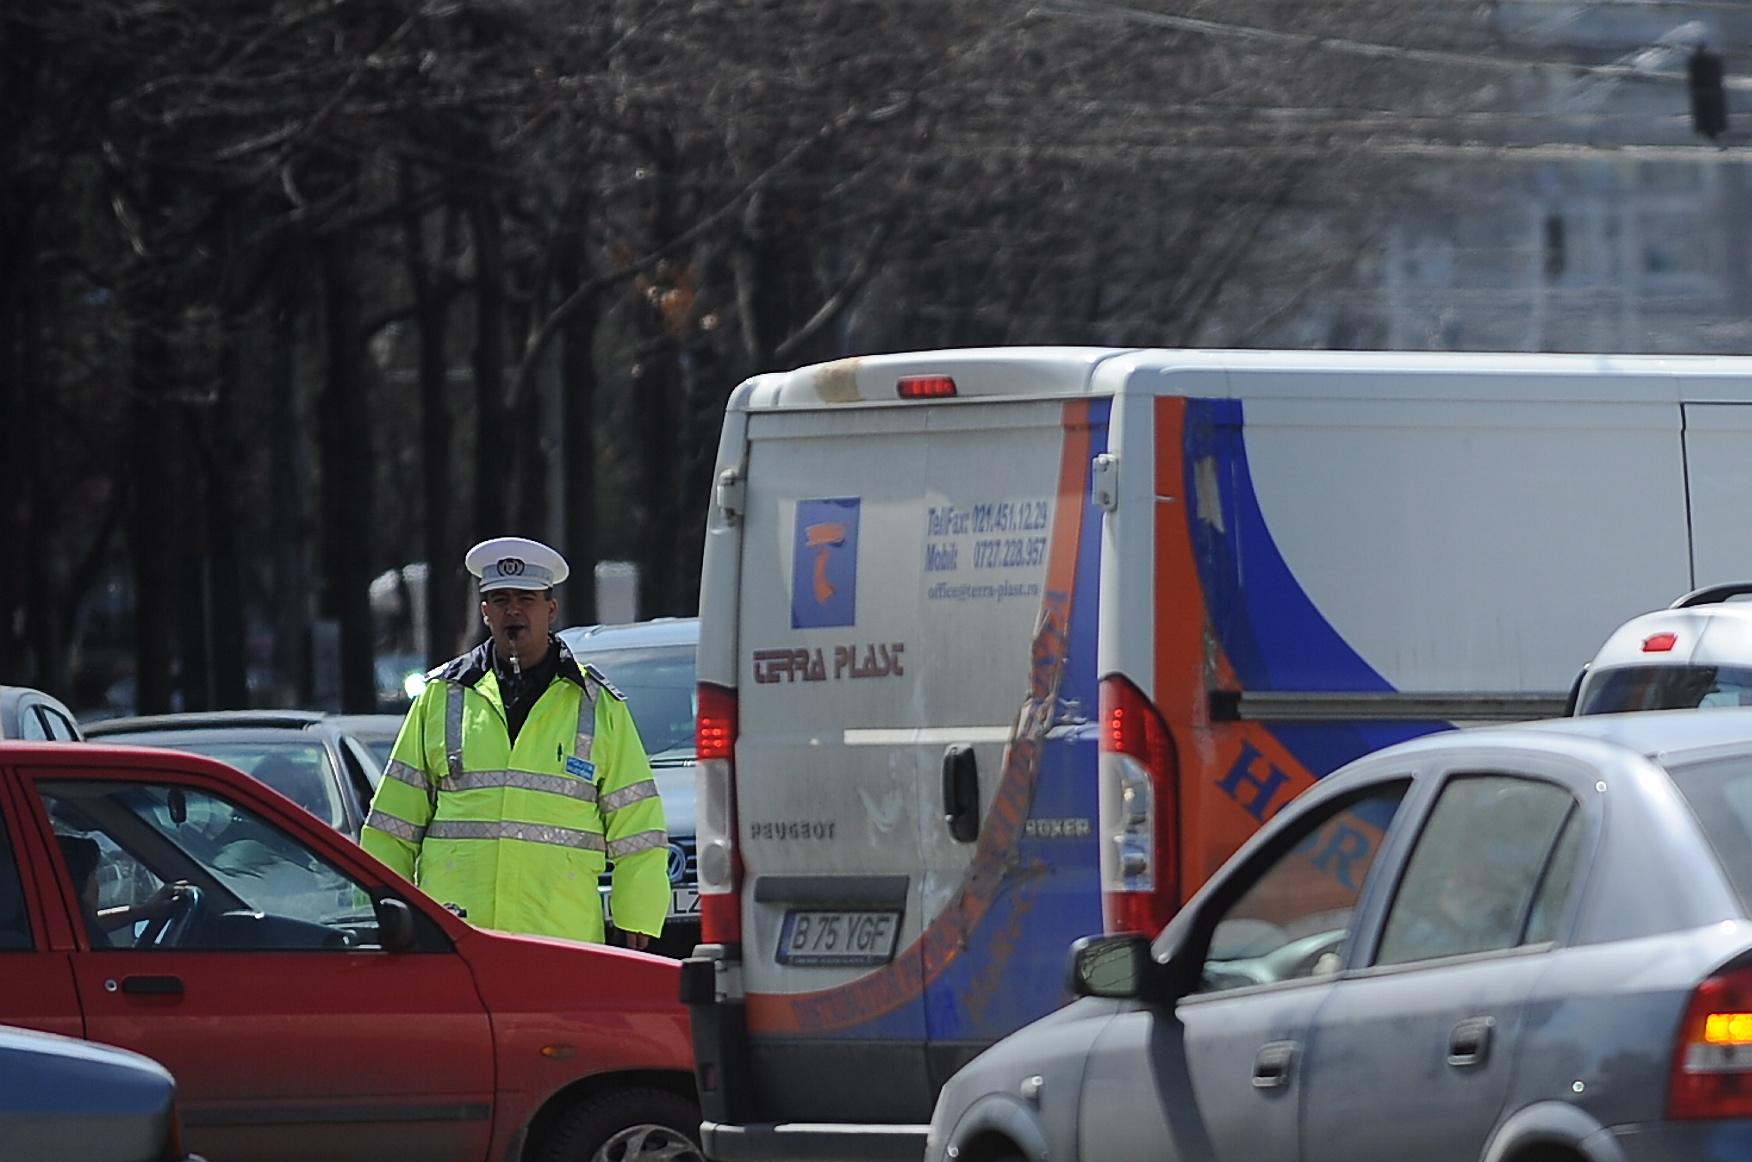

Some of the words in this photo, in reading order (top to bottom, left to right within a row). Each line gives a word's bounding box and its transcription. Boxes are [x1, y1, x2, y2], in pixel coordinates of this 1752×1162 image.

[753, 648, 827, 684] TERRA
[834, 643, 905, 679] PLAST
[751, 821, 835, 840] PEUGEOT
[792, 916, 811, 949] B
[812, 917, 841, 950] 75
[846, 915, 890, 951] YGF
